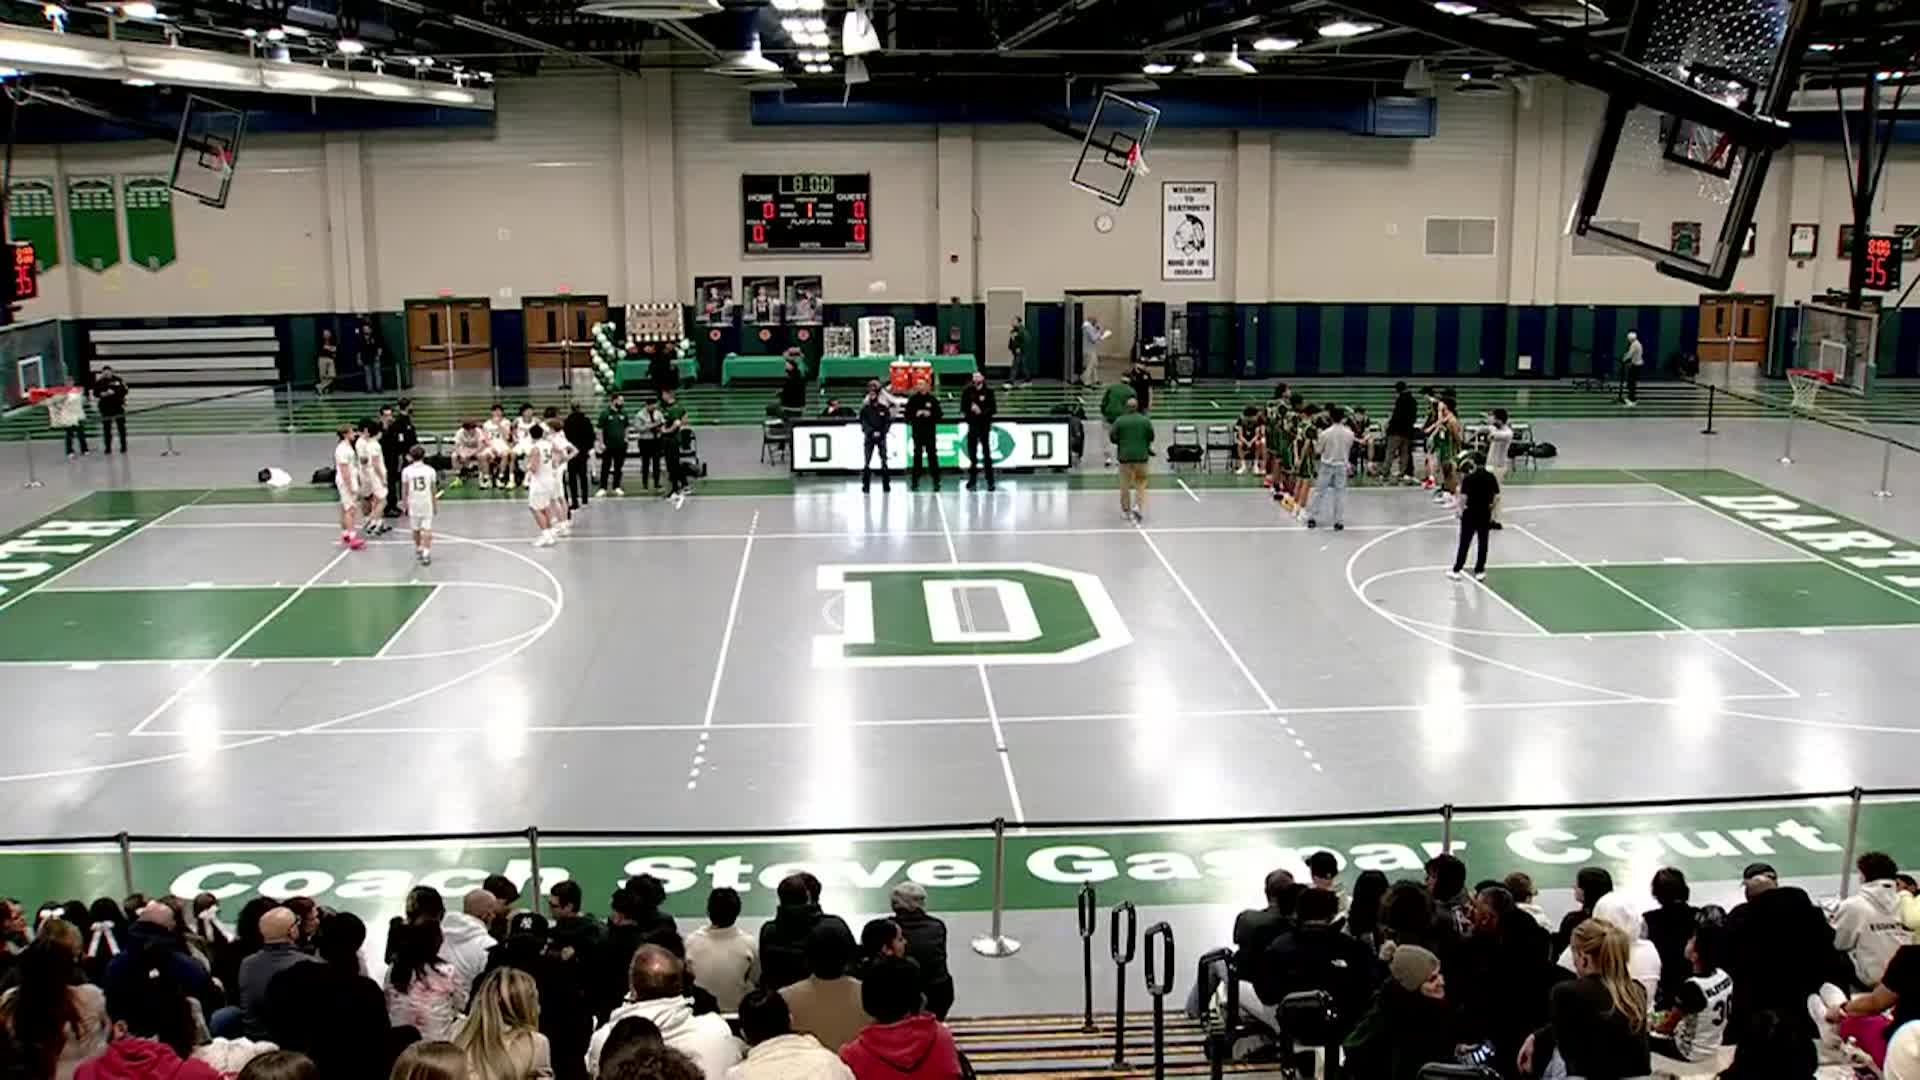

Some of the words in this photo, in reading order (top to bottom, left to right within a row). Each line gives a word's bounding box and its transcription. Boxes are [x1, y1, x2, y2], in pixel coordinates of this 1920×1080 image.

[747, 194, 774, 202] HOME
[836, 193, 868, 202] GUEST
[762, 202, 776, 219] 0
[852, 201, 865, 218] 0
[752, 224, 765, 243] 0
[14, 265, 33, 295] 35
[1865, 255, 1886, 286] 35
[809, 433, 832, 462] D
[1032, 431, 1054, 459] D
[412, 476, 426, 491] 13
[812, 562, 1135, 668] D
[169, 859, 571, 900] Coach
[617, 855, 982, 893] Steve
[1505, 818, 1843, 864] Court
